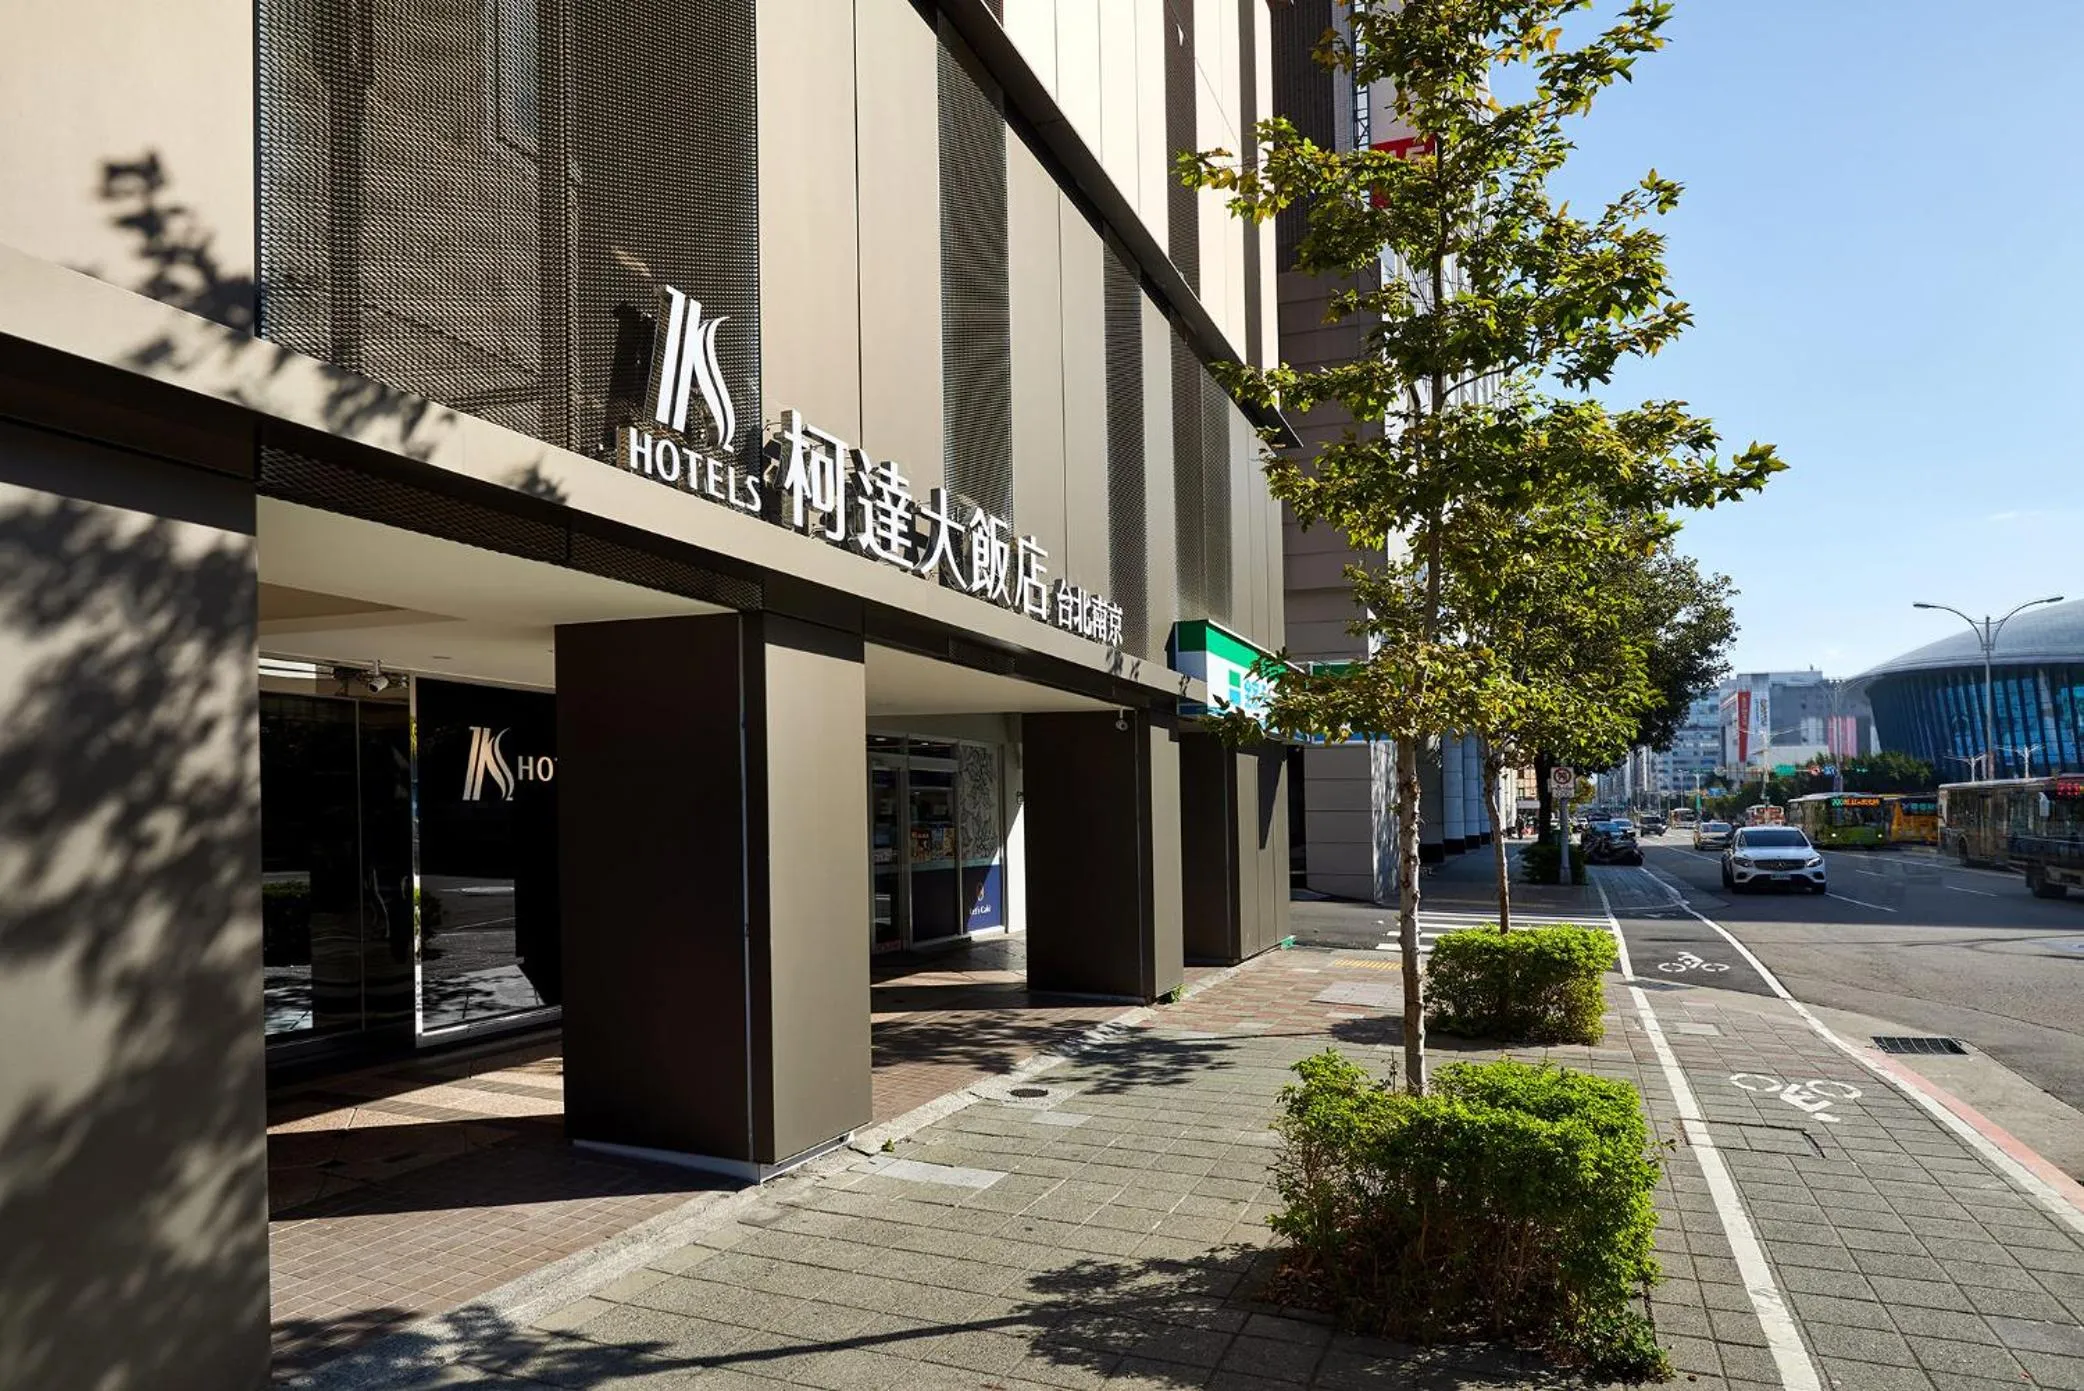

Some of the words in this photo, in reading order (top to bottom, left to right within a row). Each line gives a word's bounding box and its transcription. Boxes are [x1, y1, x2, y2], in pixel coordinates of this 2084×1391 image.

[629, 426, 763, 513] HOTELS
[783, 408, 1049, 621] 柯達大飯店
[1056, 577, 1124, 648] 台北南京
[517, 755, 559, 782] HO
